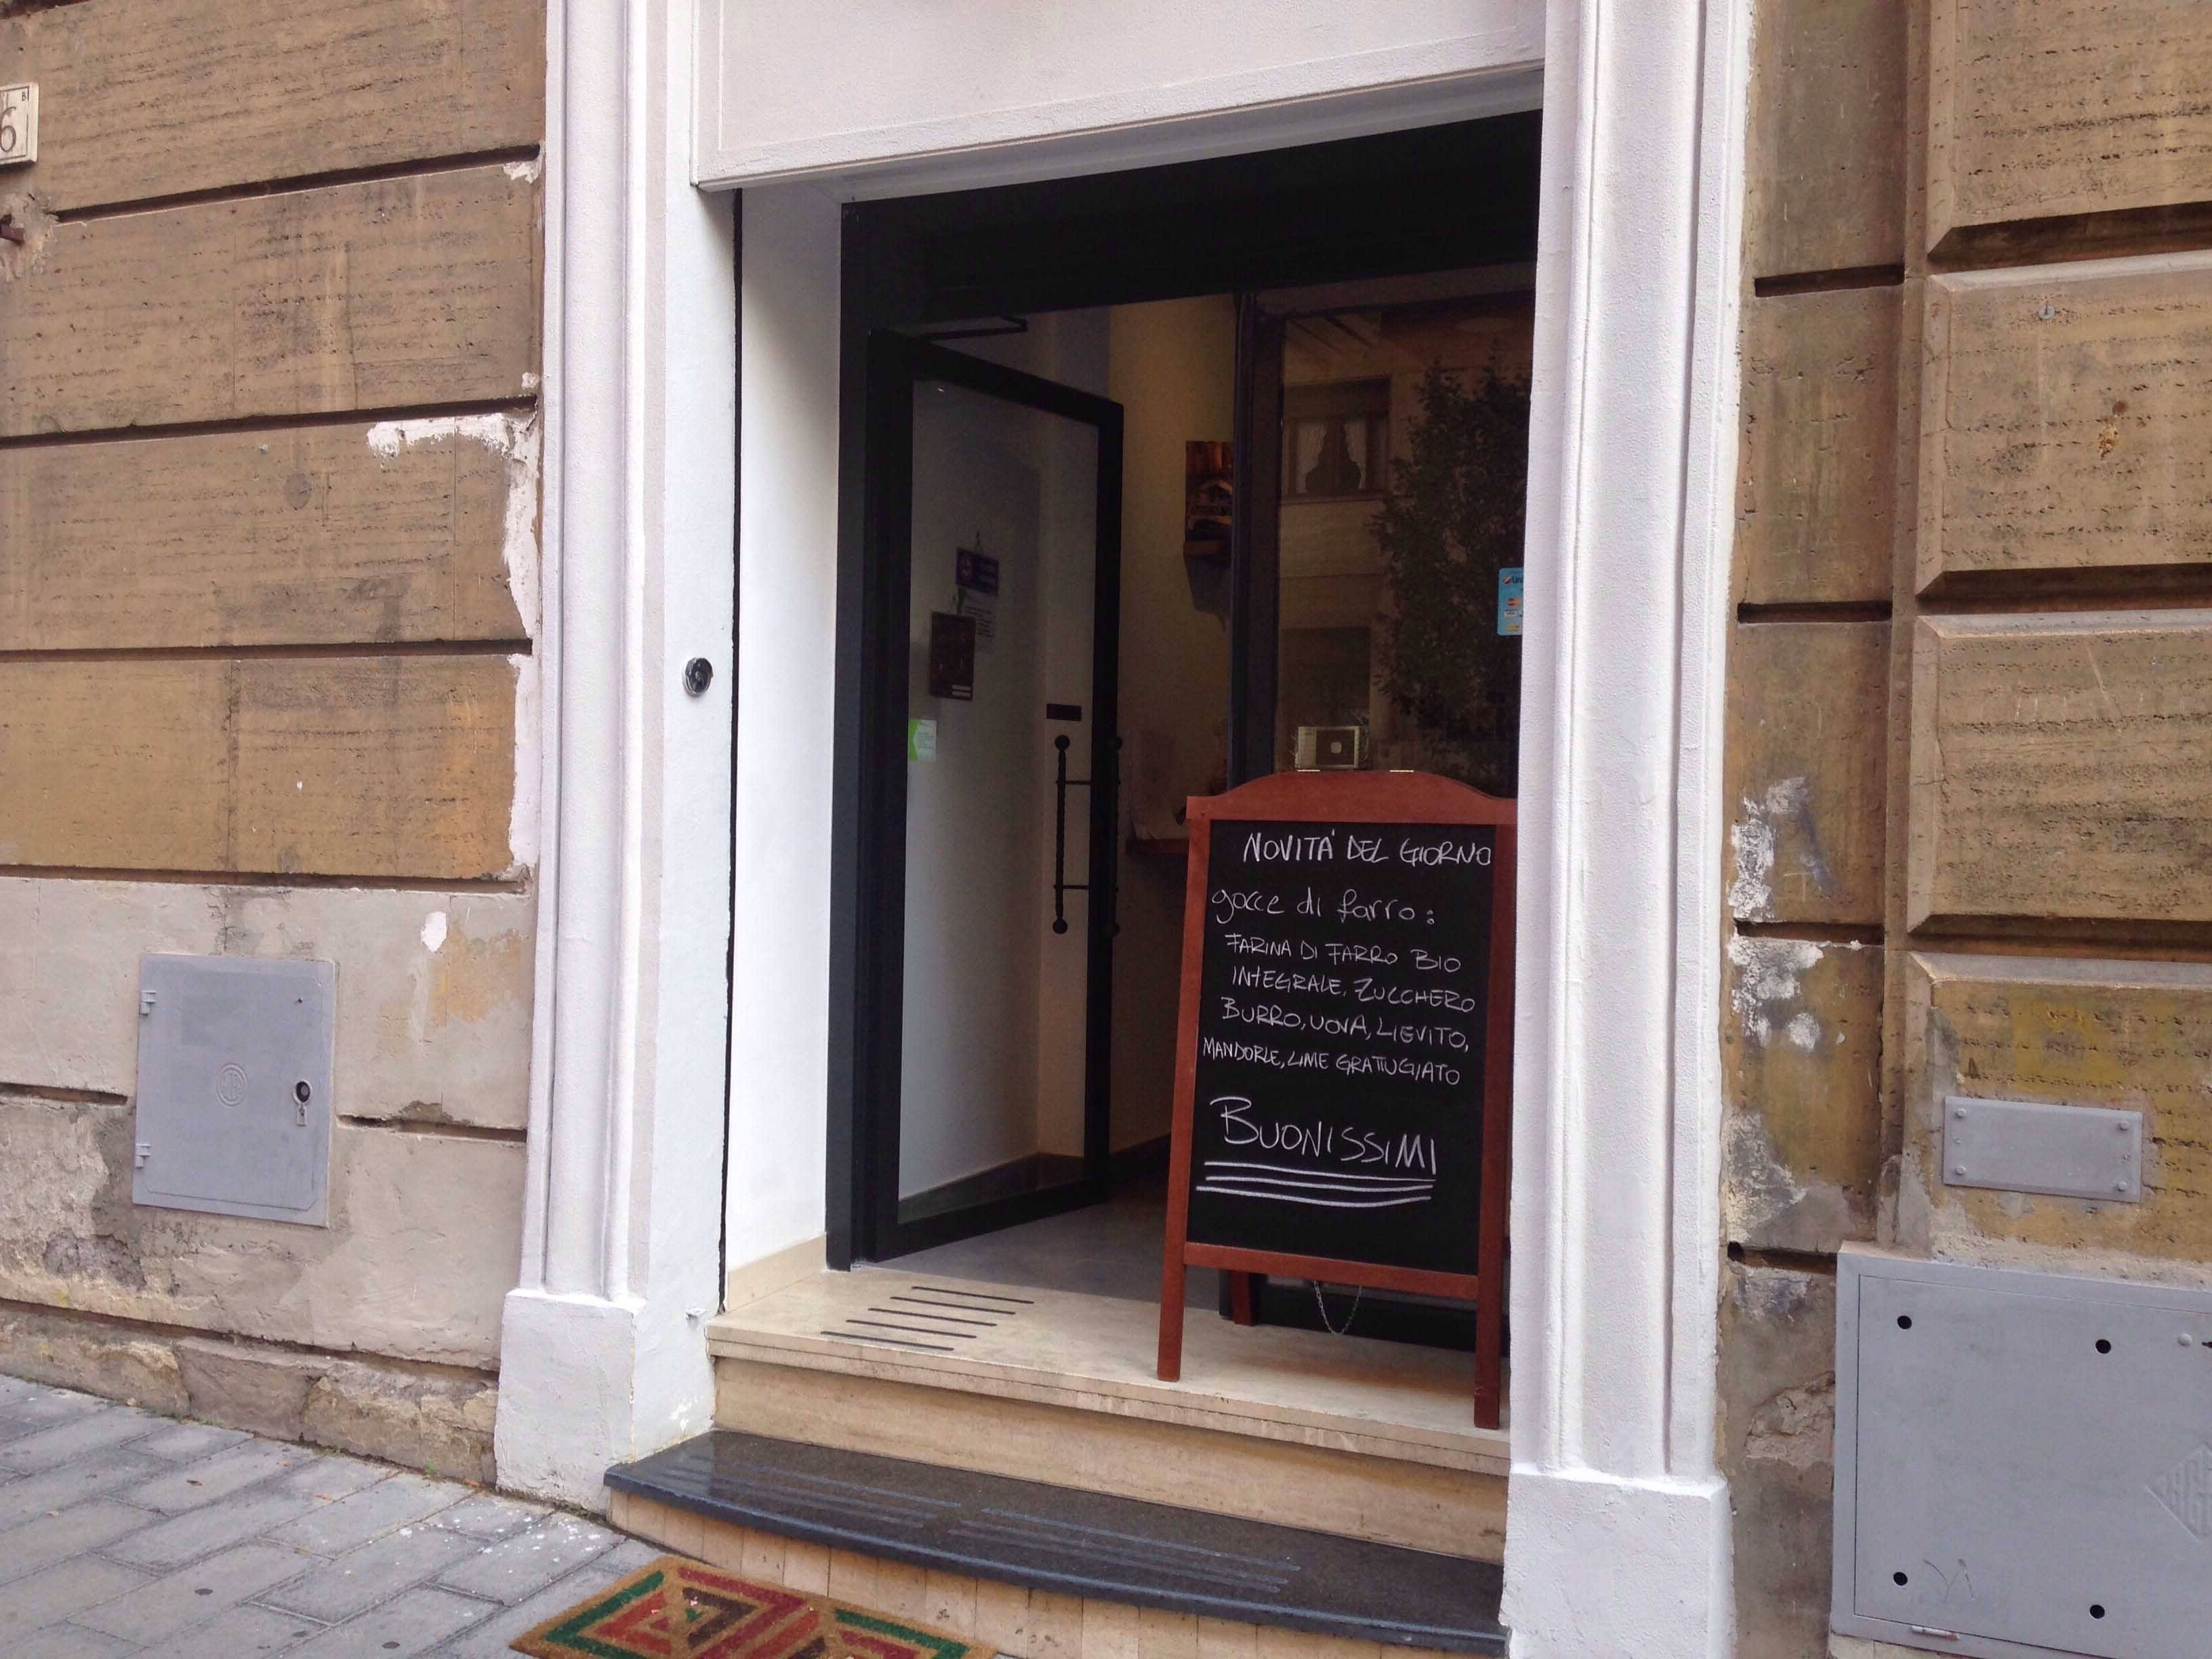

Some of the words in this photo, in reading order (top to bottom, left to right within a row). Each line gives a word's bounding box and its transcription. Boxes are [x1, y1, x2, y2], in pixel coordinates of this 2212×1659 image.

[1347, 835, 1389, 863] DEL
[1400, 838, 1491, 867] GIORNO
[1212, 889, 1285, 924] gocce
[1297, 886, 1321, 917] di
[1225, 933, 1292, 957] FARINA
[1300, 940, 1317, 960] DI
[1325, 943, 1398, 966] FARRO
[1410, 949, 1460, 972] BIO
[1354, 978, 1475, 1012] ZUCCHERO
[1288, 1051, 1329, 1069] LIME
[1336, 1054, 1460, 1085] GRATTUGIATO
[1210, 1097, 1437, 1175] BUONISSIMI
